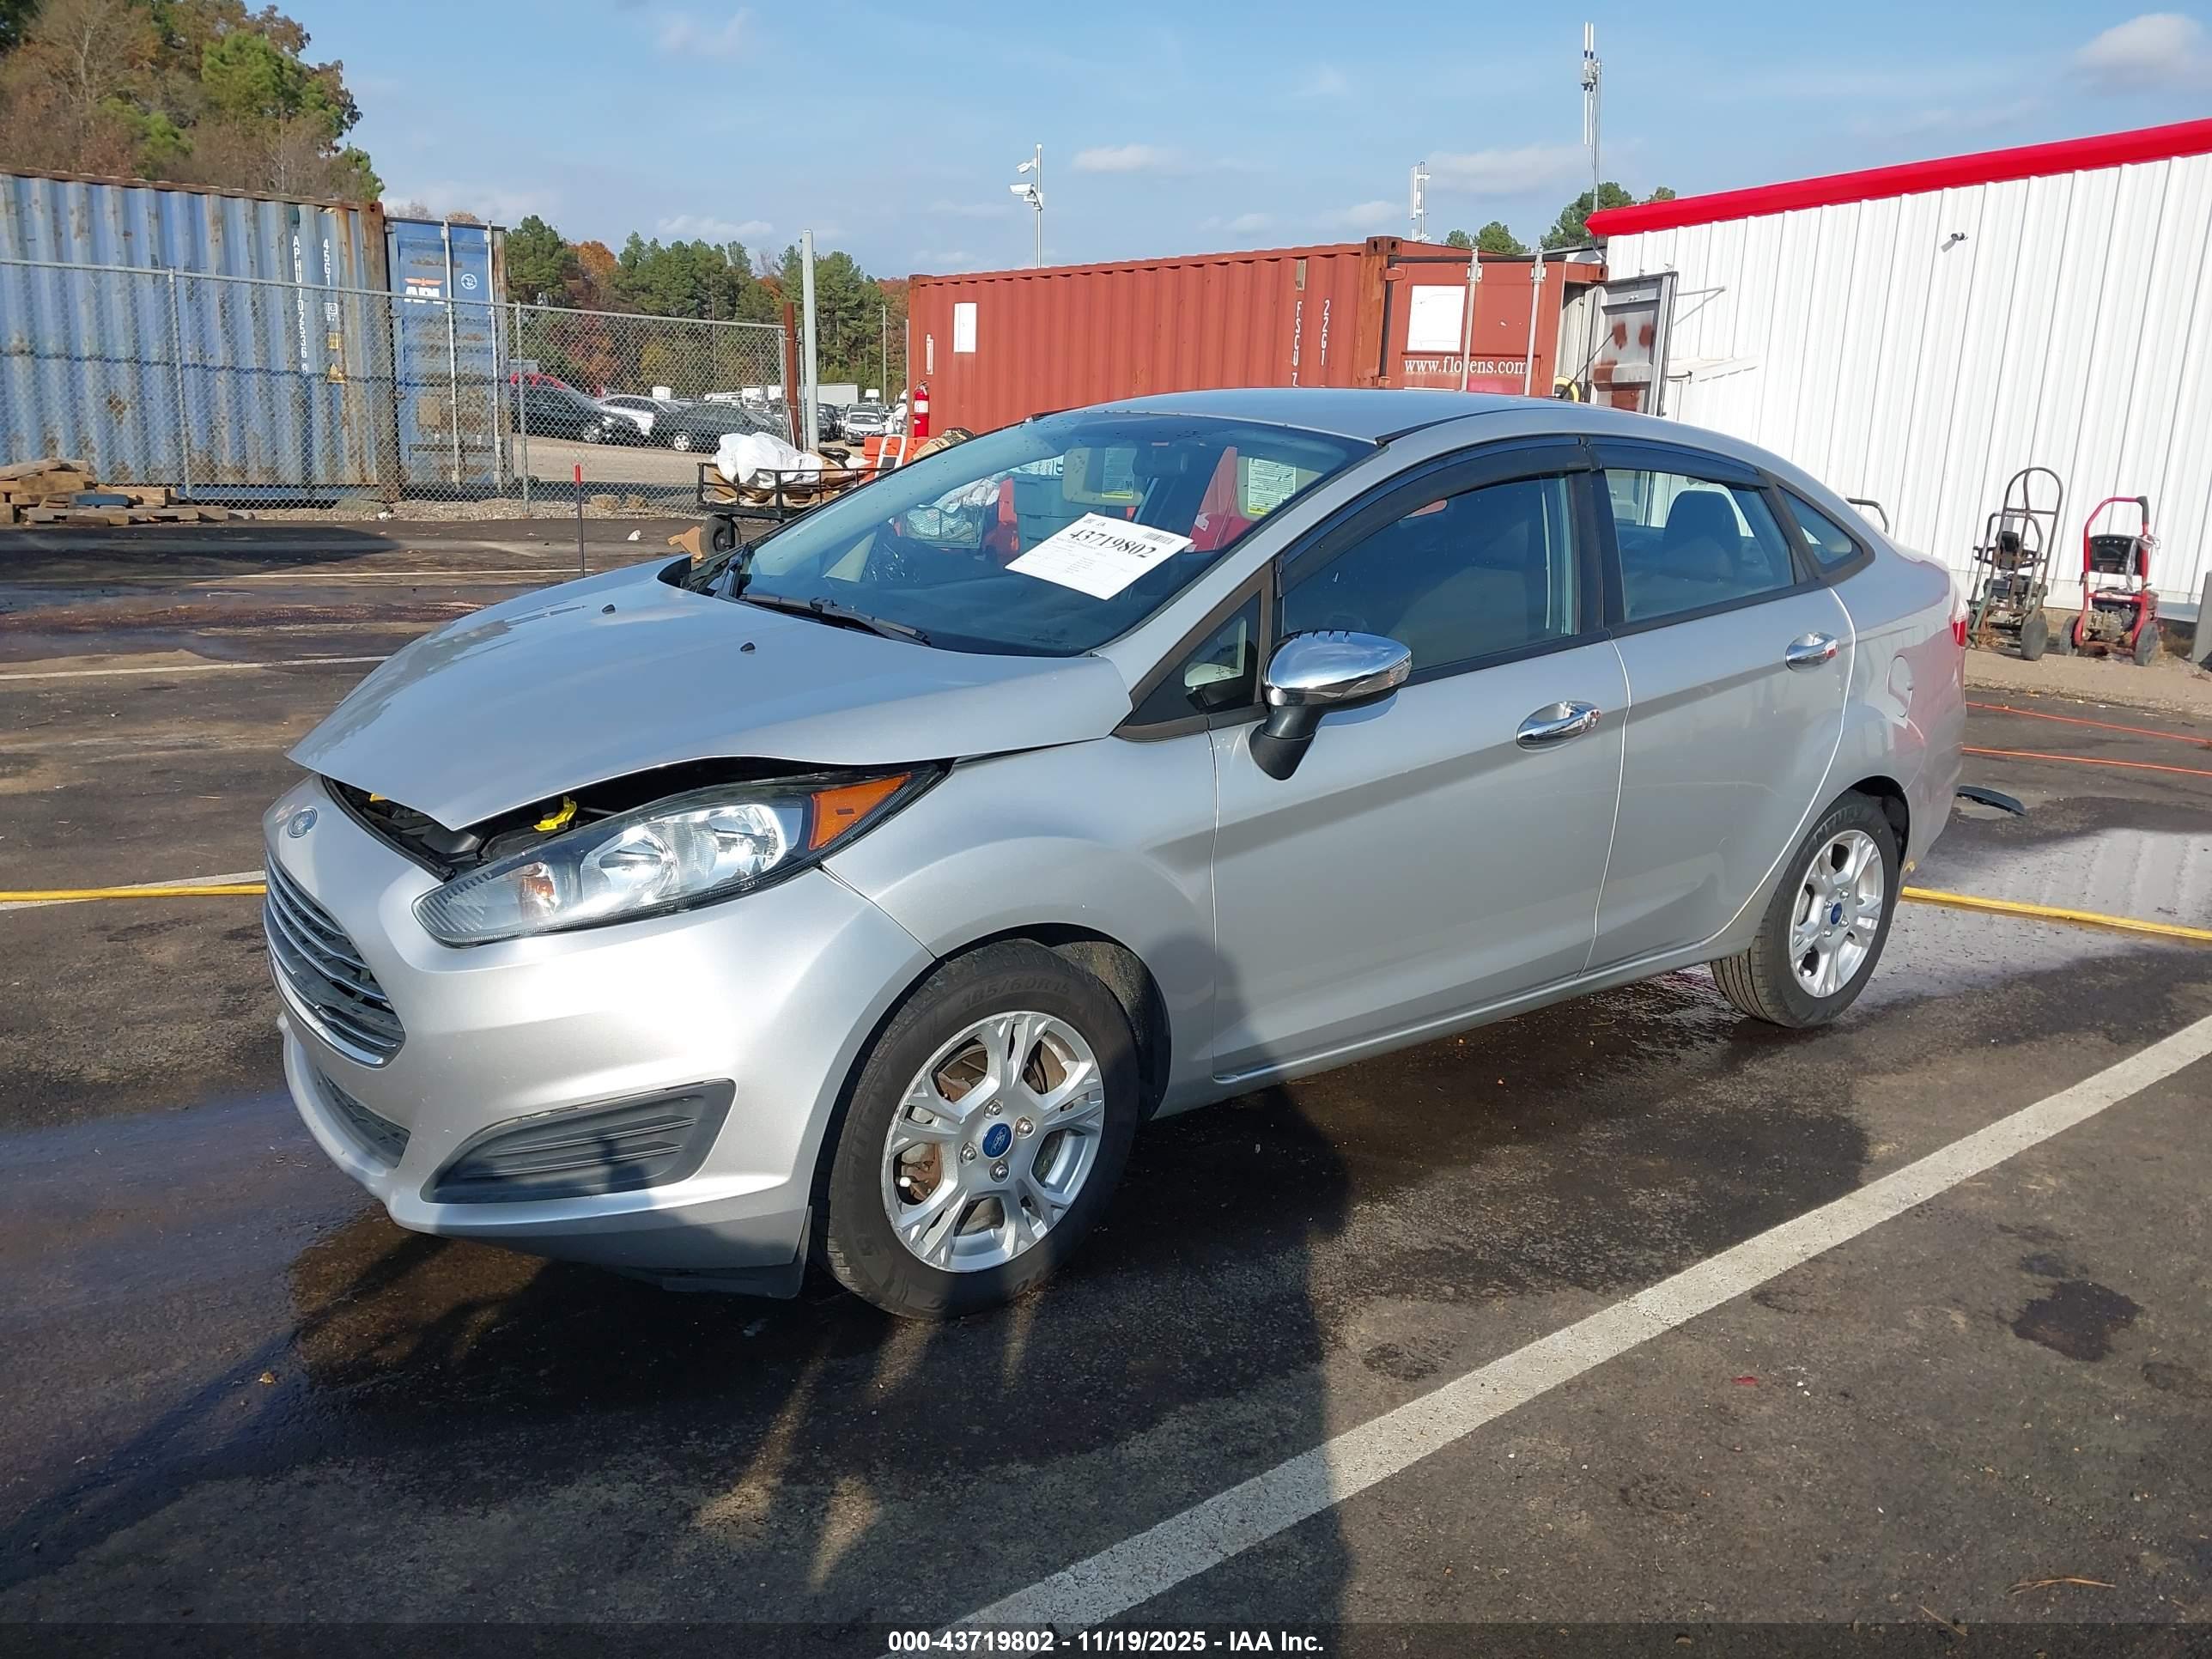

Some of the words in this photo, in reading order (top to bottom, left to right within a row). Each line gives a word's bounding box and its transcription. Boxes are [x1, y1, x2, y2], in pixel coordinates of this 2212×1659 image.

[292, 235, 302, 283] APHU
[323, 239, 331, 286] 45G1
[296, 289, 307, 359] 702536
[1292, 301, 1303, 367] FSCU
[1321, 299, 1330, 366] 22G1
[1404, 356, 1527, 374] www.floens.com
[1069, 529, 1158, 559] 43719802
